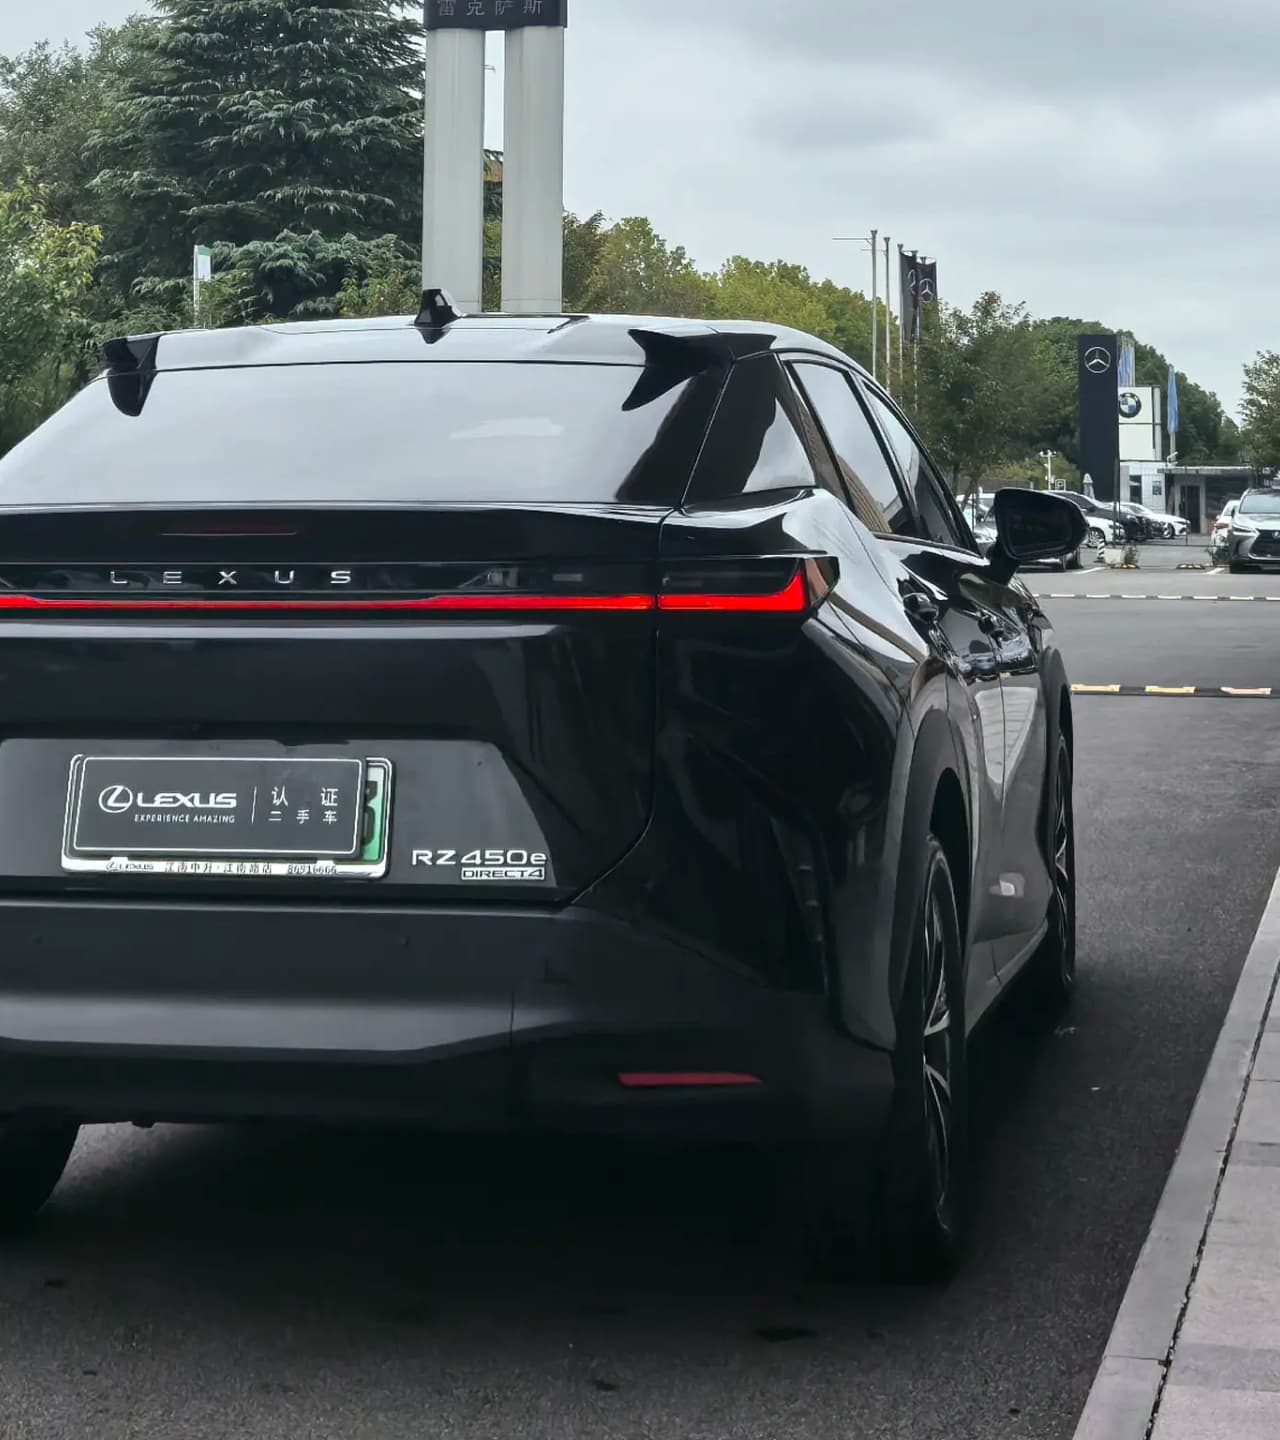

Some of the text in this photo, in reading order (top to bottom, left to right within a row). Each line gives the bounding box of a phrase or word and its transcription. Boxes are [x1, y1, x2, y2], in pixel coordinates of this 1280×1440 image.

[110, 570, 352, 585] LEXUS
[137, 792, 237, 809] LEXUS
[134, 813, 235, 823] EXPERIENCE AMAZING
[412, 849, 547, 865] RZ 450e
[463, 869, 543, 879] DIRECT4
